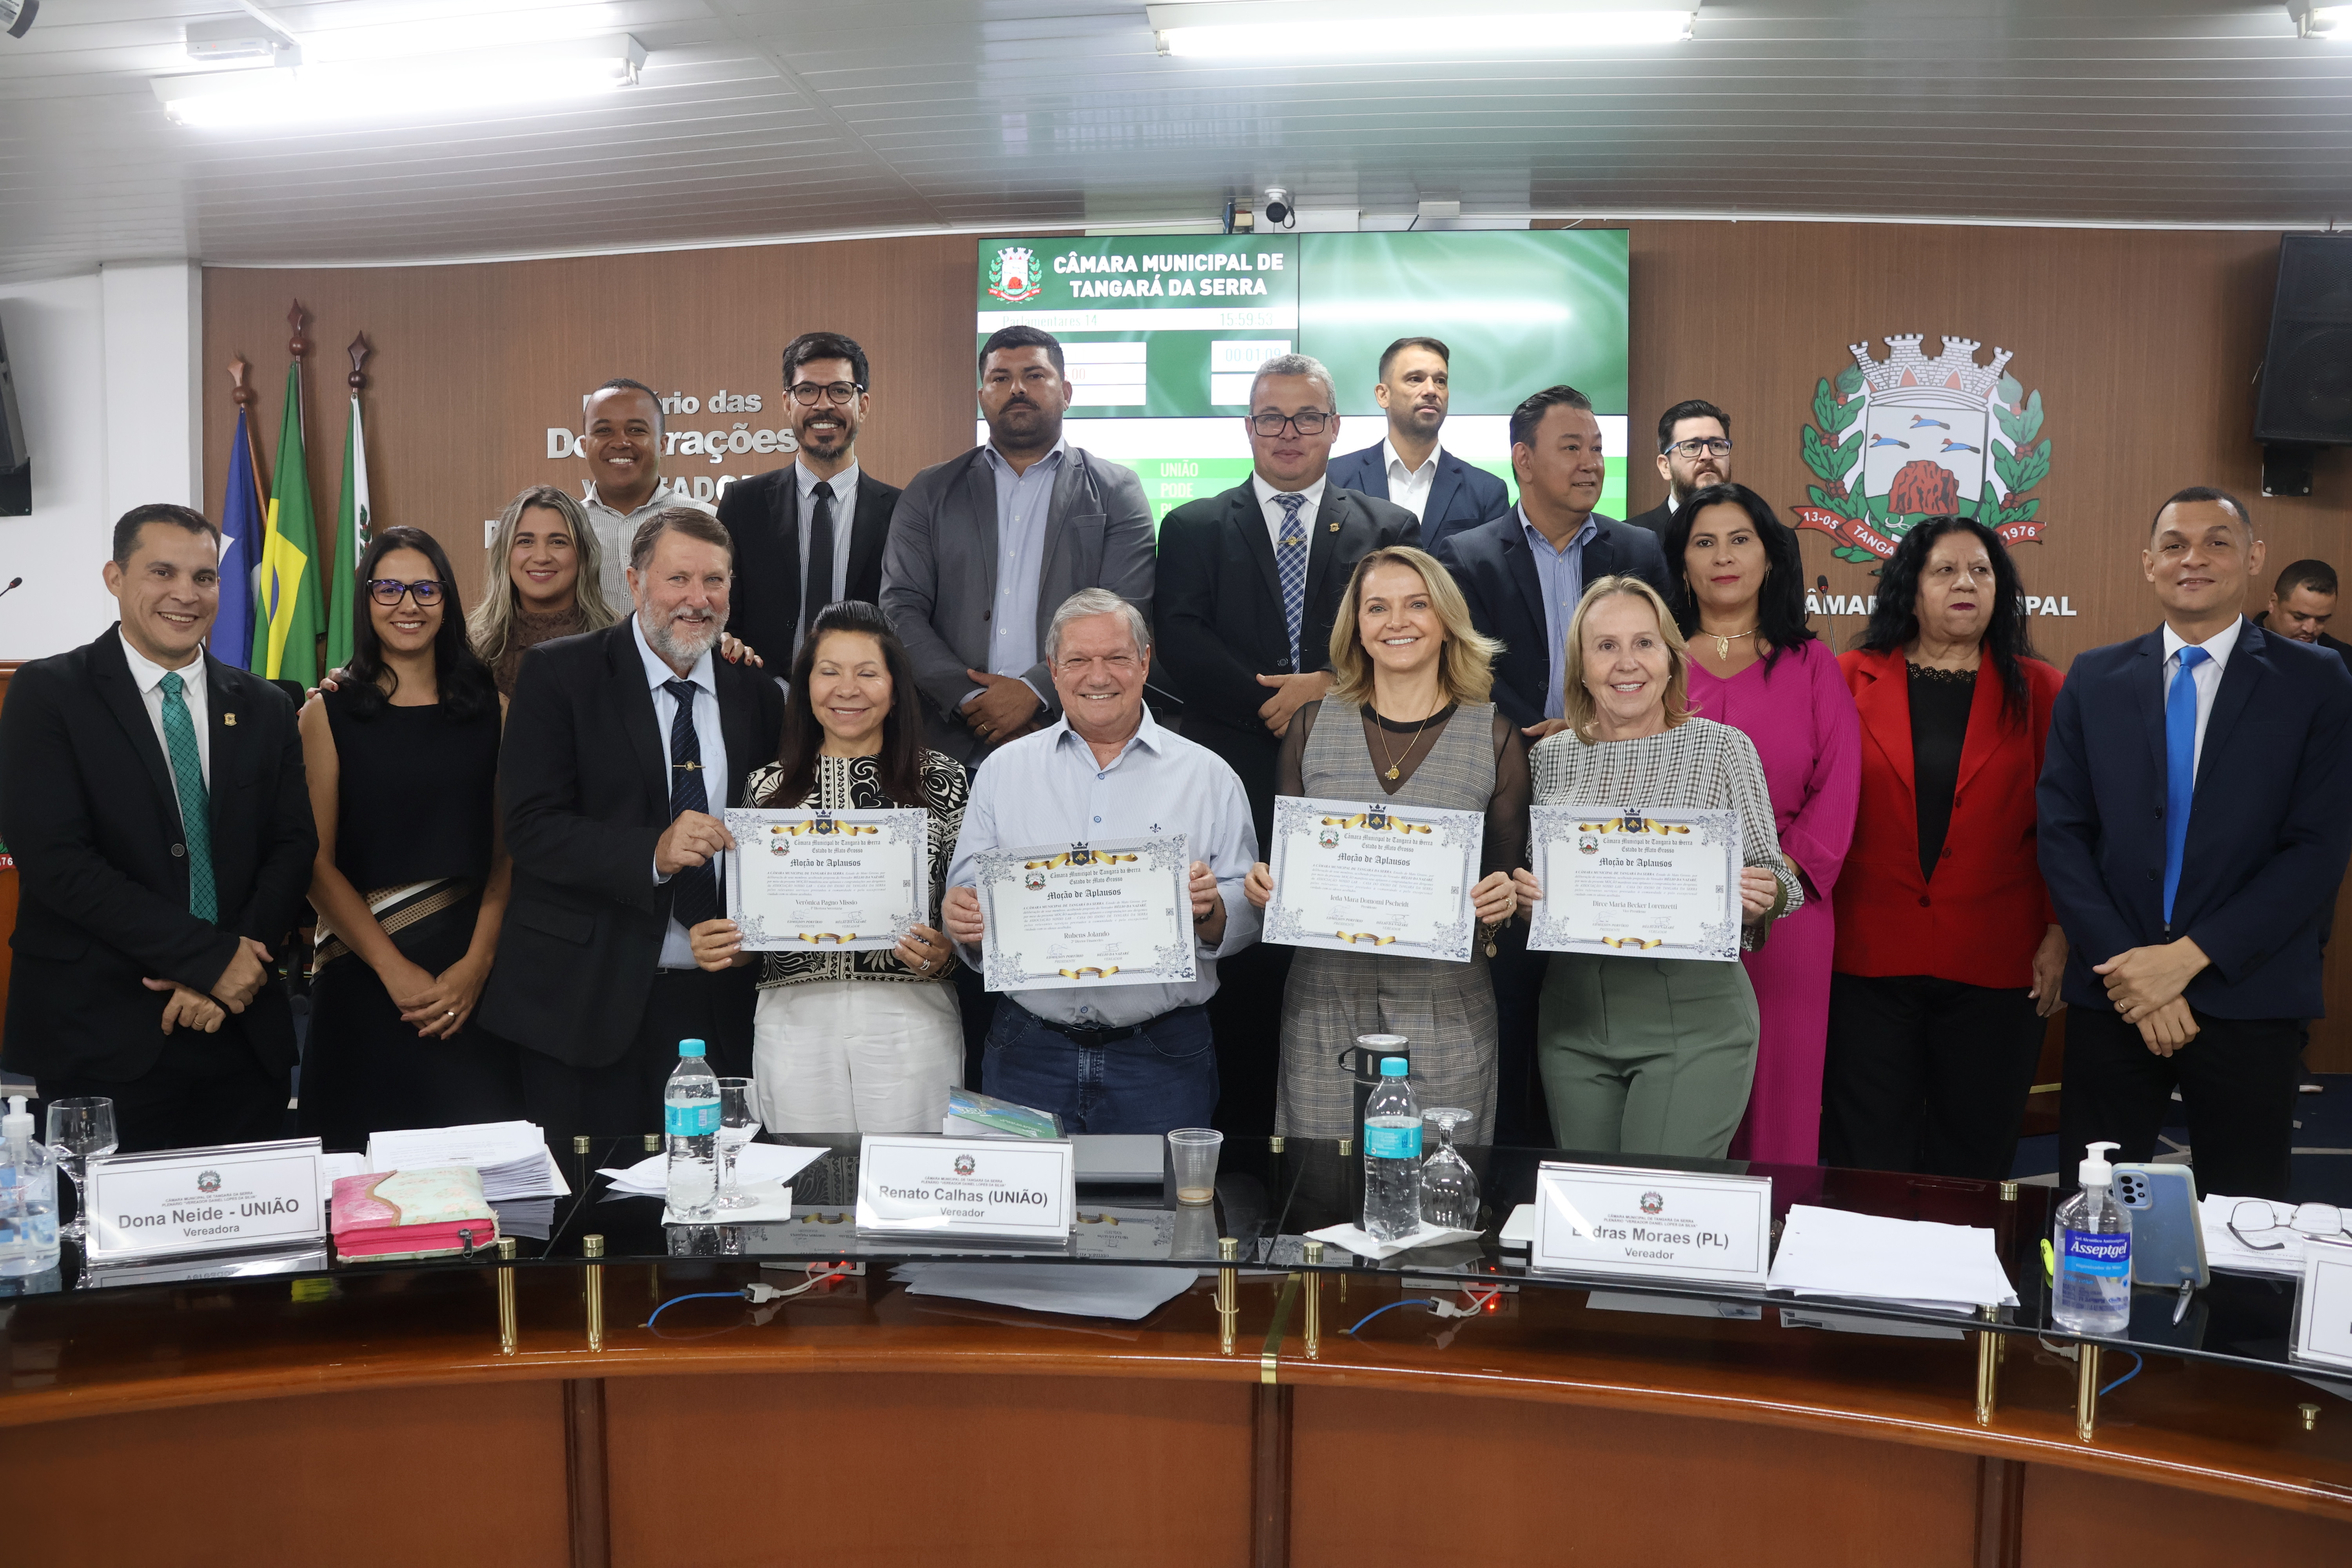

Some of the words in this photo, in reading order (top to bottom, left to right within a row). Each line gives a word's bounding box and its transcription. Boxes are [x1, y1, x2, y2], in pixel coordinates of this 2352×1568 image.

[1054, 251, 1138, 274] CÂMARA
[1143, 253, 1252, 272] MUNICIPAL
[1257, 253, 1283, 270] DE
[1069, 274, 1164, 298] TANGARÁ
[1169, 279, 1196, 296] DA
[1200, 278, 1267, 296] SERRA
[1003, 315, 1081, 327] Parlamentares
[1085, 314, 1097, 327] 14
[1220, 312, 1273, 326] 15:59:53
[708, 390, 762, 413] das
[1160, 459, 1198, 477] UNIÃO
[1160, 483, 1194, 497] PODE
[1804, 512, 1838, 529] 13-05
[1854, 525, 1894, 555] TANGA
[2003, 526, 2035, 540] 1976
[790, 859, 814, 867] Moção
[1338, 853, 1362, 863] Moção
[1375, 856, 1410, 866] Aplausos
[1599, 858, 1624, 867] Moção
[1637, 858, 1672, 867] Aplausos
[1047, 891, 1072, 900] Moção
[1085, 889, 1121, 897] Aplausos
[879, 1186, 929, 1199] Renato
[935, 1189, 983, 1201] Calhas
[989, 1189, 1047, 1207] (UNIÃO)
[119, 1215, 165, 1228] Dona
[173, 1207, 223, 1223] Neide
[241, 1198, 299, 1216] UNIÃO
[940, 1208, 985, 1217] Vereador
[183, 1225, 240, 1236] Vereadora
[1572, 1226, 1626, 1239] Edras
[1633, 1228, 1690, 1244] Moraes
[1697, 1232, 1728, 1249] (PL)
[1625, 1248, 1674, 1259] Vereador
[2071, 1241, 2127, 1258] Asseptgel
